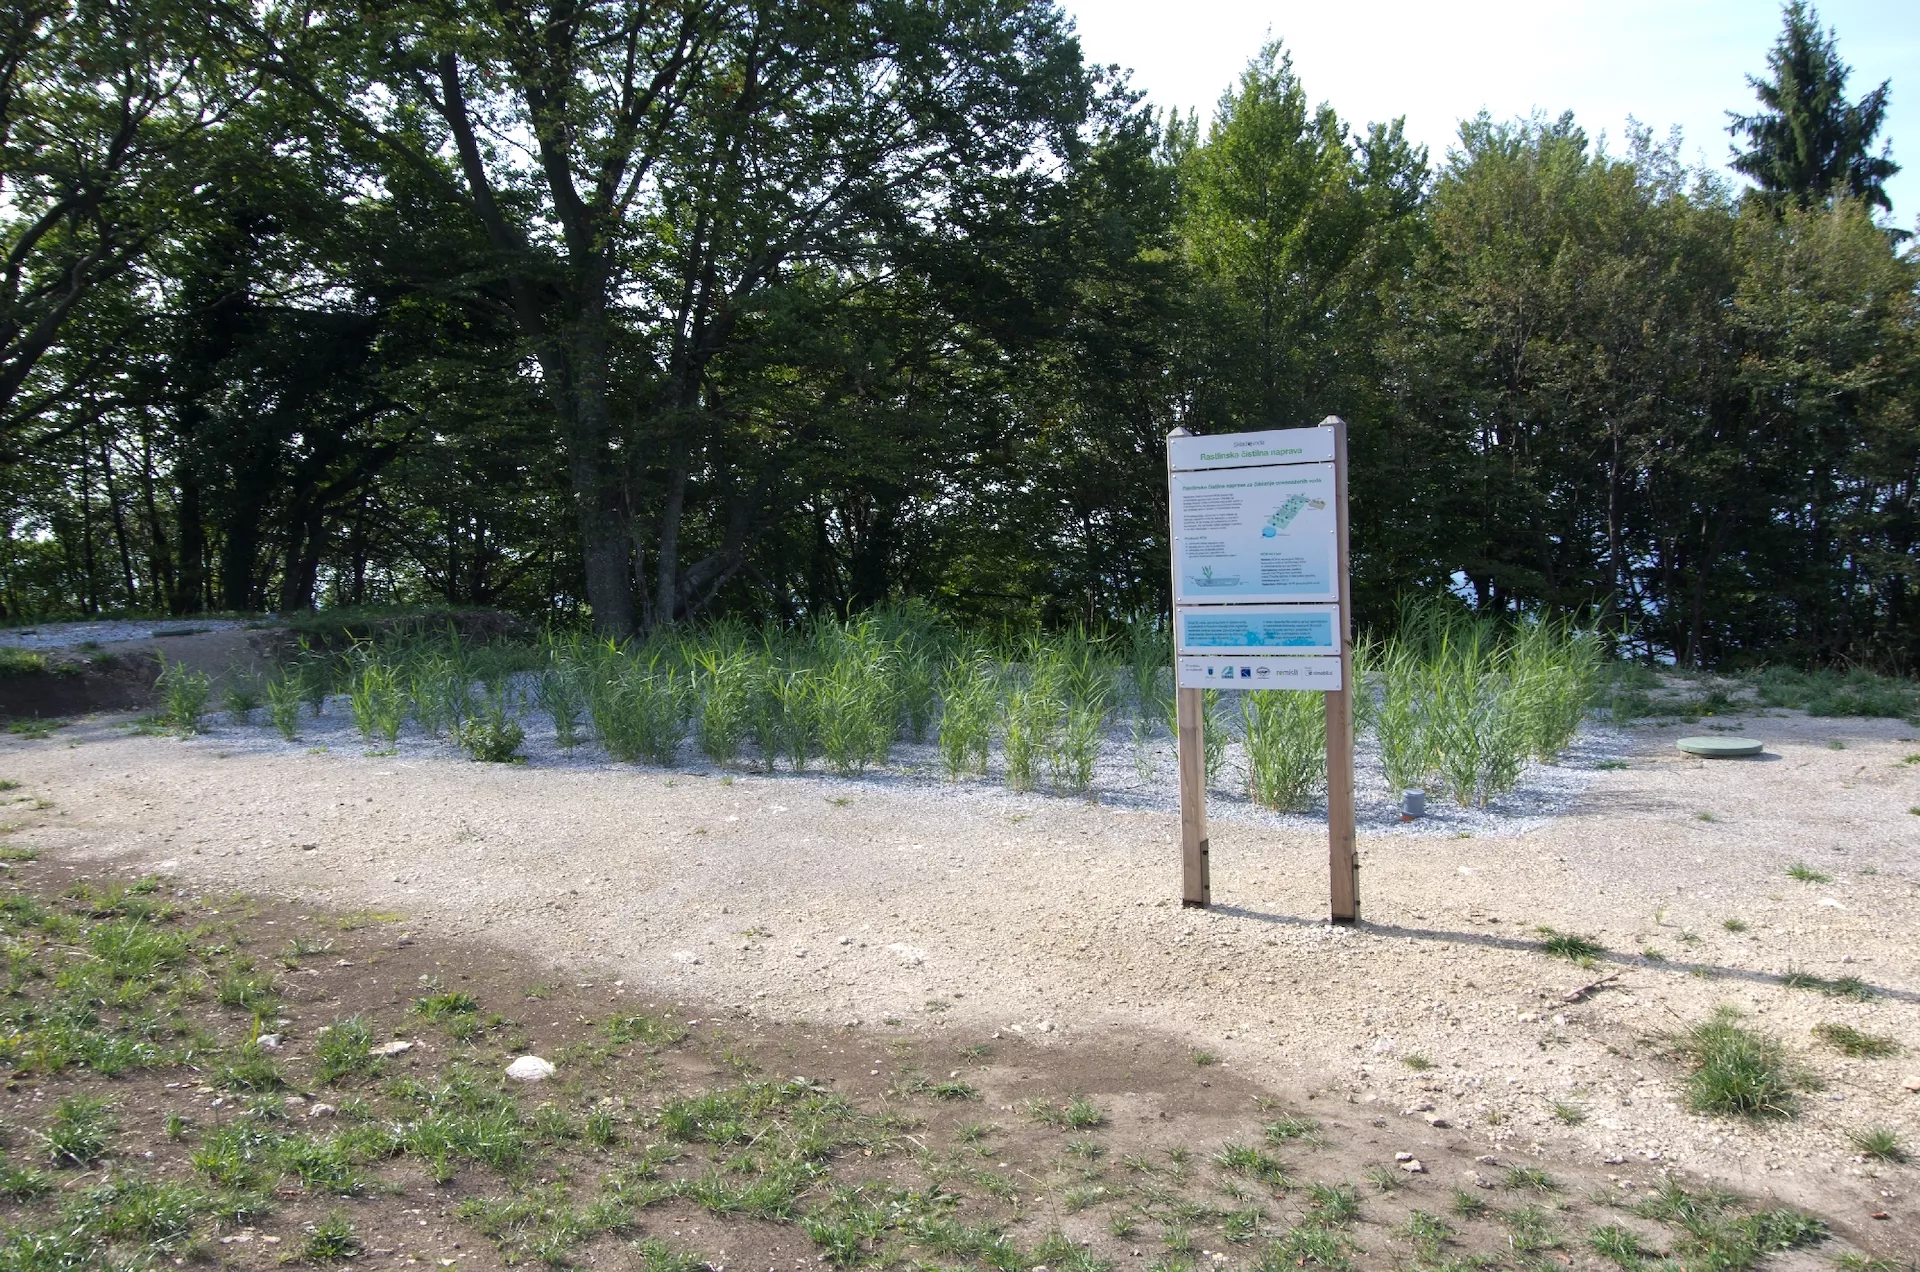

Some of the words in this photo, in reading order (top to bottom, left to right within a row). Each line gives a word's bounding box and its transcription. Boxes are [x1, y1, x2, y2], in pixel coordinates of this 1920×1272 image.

[1200, 451, 1239, 461] Rastlinska
[1241, 449, 1268, 458] čistilna
[1270, 447, 1303, 457] naprava
